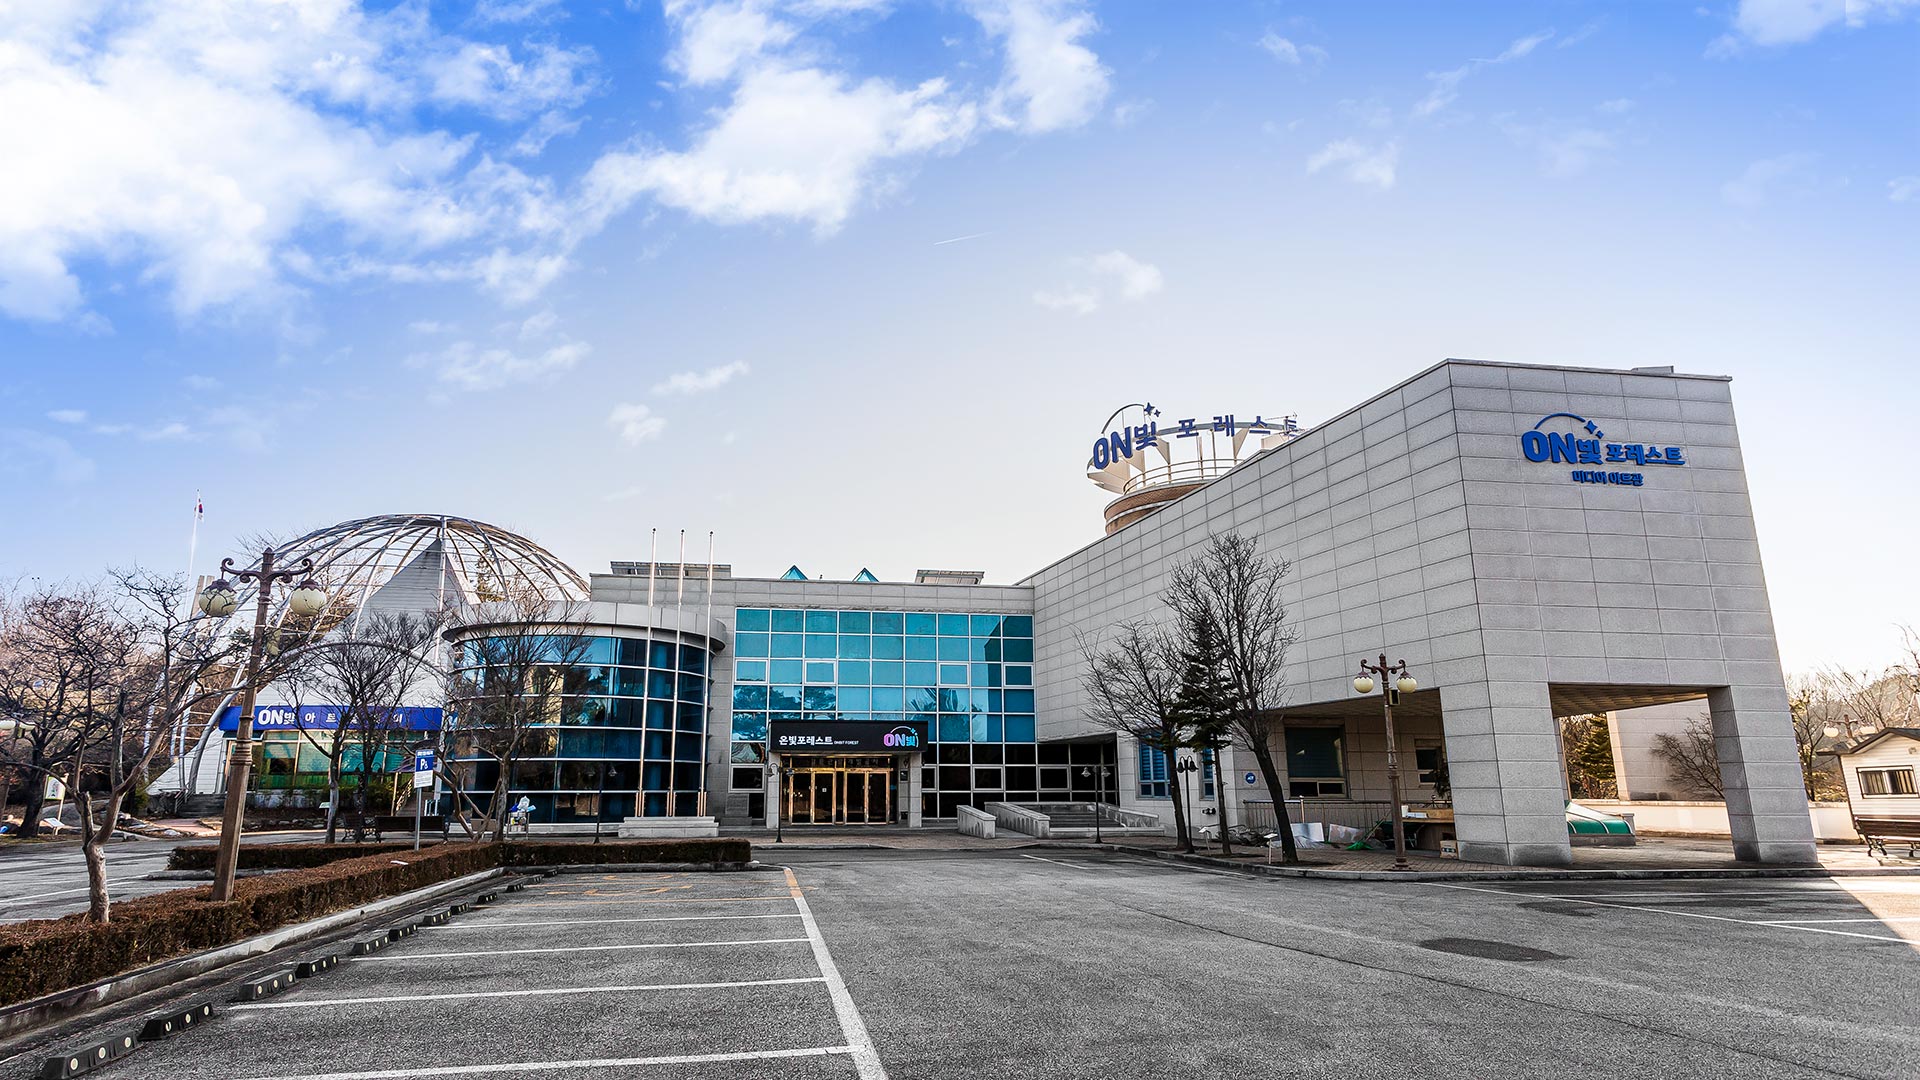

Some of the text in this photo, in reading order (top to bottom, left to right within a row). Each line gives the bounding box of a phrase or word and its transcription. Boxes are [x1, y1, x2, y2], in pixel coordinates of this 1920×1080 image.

[1093, 414, 1298, 469] ON빛 포레스트
[1521, 430, 1686, 465] ON빛 포레스트
[1571, 470, 1644, 486] 미디어 아트관
[779, 735, 833, 746] 온빛포레스트
[883, 733, 916, 747] ON빛
